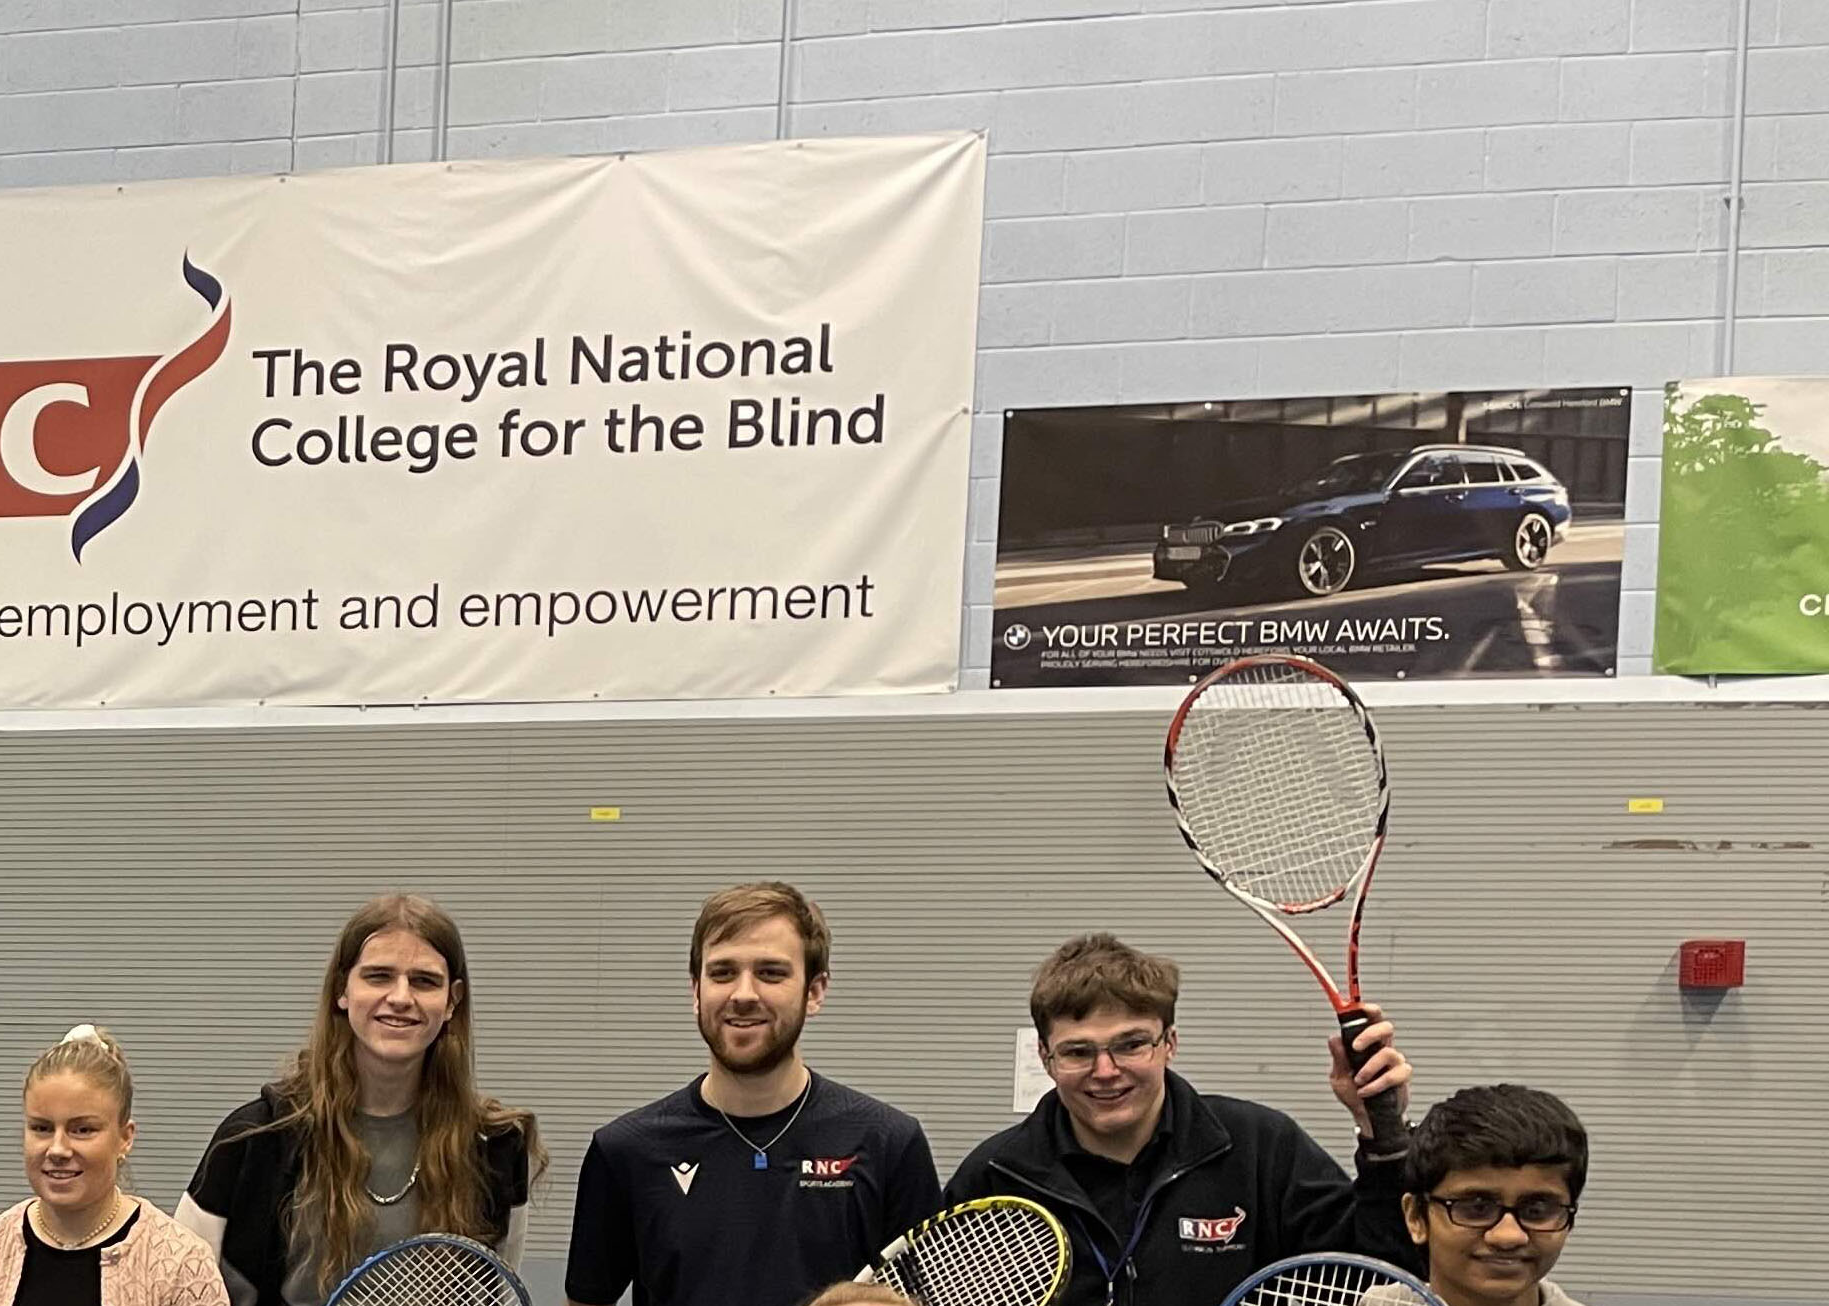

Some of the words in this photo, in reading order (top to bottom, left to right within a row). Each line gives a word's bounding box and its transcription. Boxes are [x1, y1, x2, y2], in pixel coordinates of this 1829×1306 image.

[253, 348, 362, 398] The
[383, 338, 549, 402] Royal
[571, 323, 835, 384] National
[251, 414, 478, 473] College
[499, 409, 585, 458] for
[605, 404, 705, 453] the
[728, 394, 886, 450] Blind
[339, 584, 440, 630] and
[459, 575, 876, 637] empowerment
[1041, 624, 1119, 648] YOUR
[1126, 620, 1254, 646] PERFECT
[1259, 619, 1331, 643] BMW
[1335, 617, 1450, 642] AWAITS.
[801, 1159, 843, 1175] RNC
[1182, 1219, 1231, 1239] RNC
